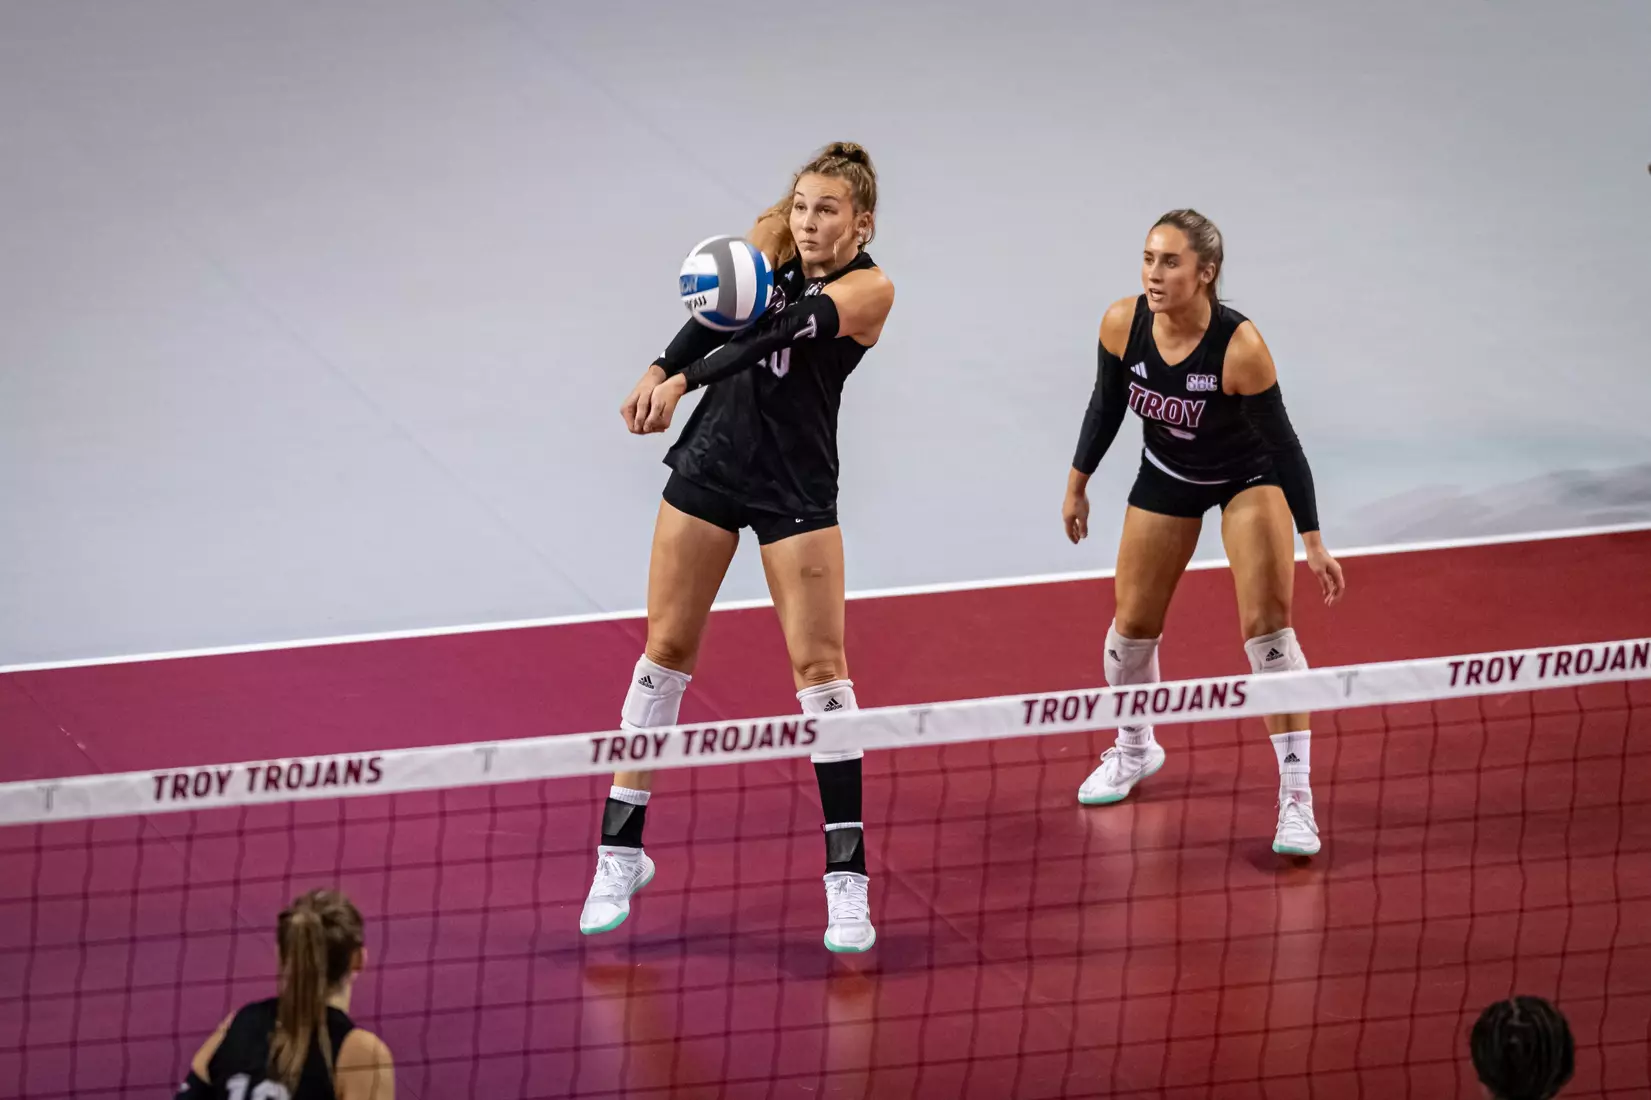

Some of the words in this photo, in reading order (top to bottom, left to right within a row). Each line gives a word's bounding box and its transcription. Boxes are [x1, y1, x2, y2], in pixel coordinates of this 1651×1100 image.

[1128, 381, 1206, 428] TROY
[1448, 655, 1526, 687] TROY
[1022, 695, 1103, 725] TROY
[1112, 680, 1248, 718] TROJANS
[590, 733, 667, 764] TROY
[682, 718, 819, 756] TROJANS
[151, 769, 236, 802] TROY
[246, 756, 385, 793] TROJANS
